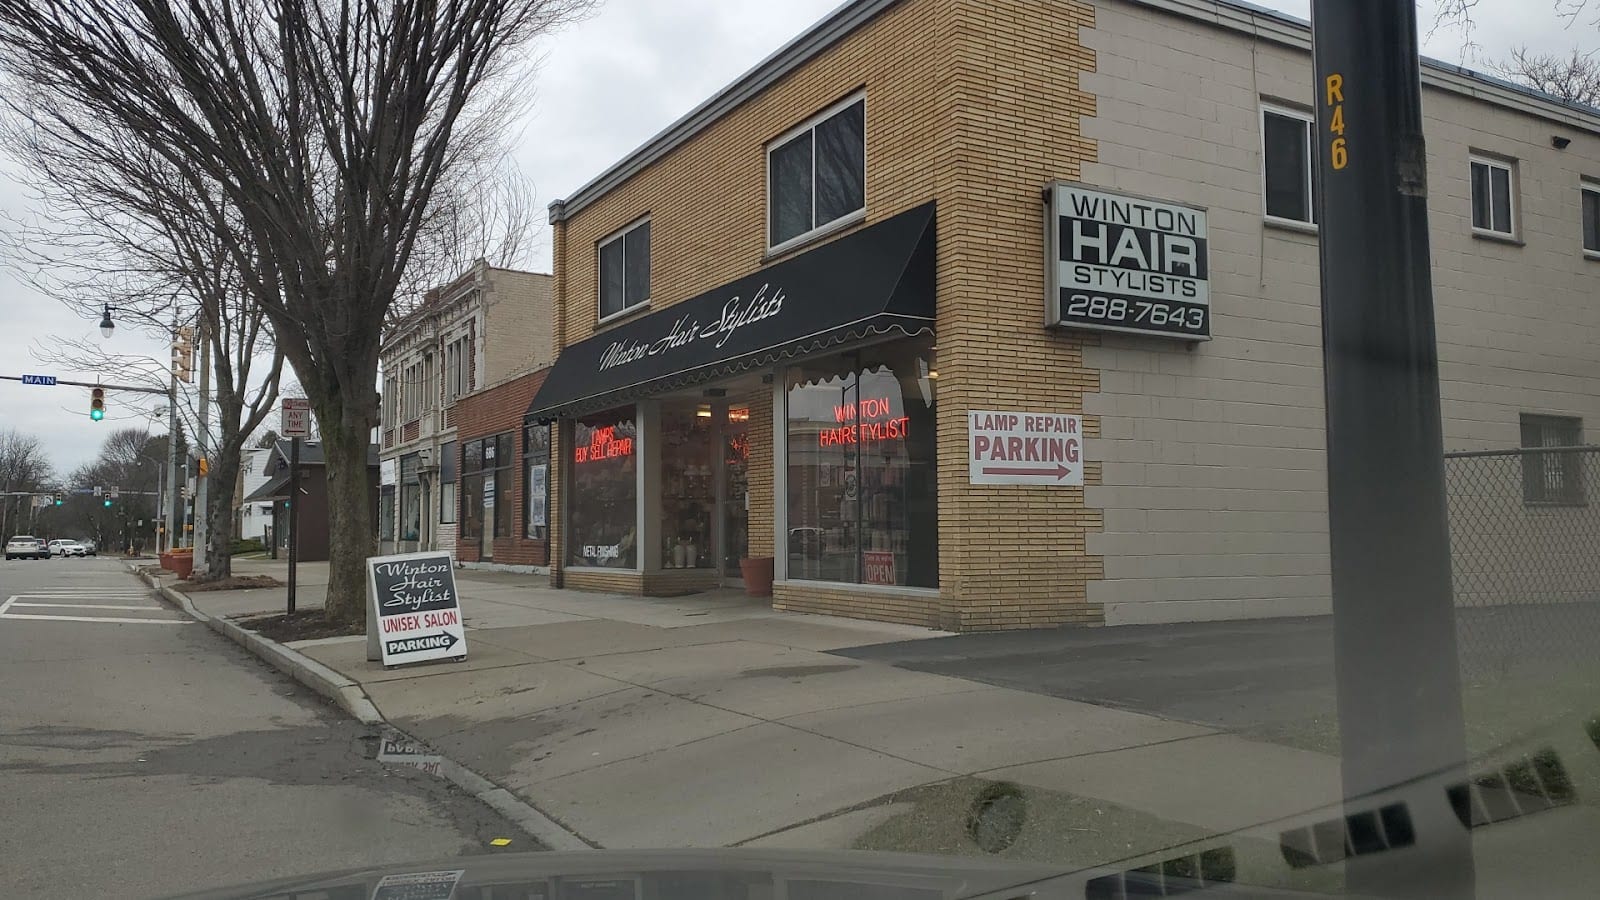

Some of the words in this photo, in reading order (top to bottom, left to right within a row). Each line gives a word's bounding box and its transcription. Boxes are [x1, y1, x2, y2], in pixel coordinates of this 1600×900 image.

[1326, 73, 1348, 170] R46
[1070, 193, 1196, 235] WINTON
[1072, 219, 1198, 277] HAIR
[1074, 265, 1196, 297] STYLISTS
[1067, 294, 1204, 329] 288-7643
[598, 337, 649, 373] Winton
[648, 313, 700, 355] Hair
[699, 283, 786, 348] Stylists
[24, 376, 55, 385] MAIN
[288, 411, 304, 420] ANY
[834, 398, 888, 422] WINTON
[288, 420, 304, 428] TIME
[820, 417, 909, 447] HAIRSTYLIST
[974, 413, 1019, 432] LAMP
[1024, 415, 1077, 434] REPAIR
[974, 435, 1079, 463] PARKING
[376, 562, 448, 577] Winton
[867, 564, 894, 583] OPEN
[389, 574, 442, 592] Hair
[383, 588, 451, 610] Stylist
[383, 616, 420, 633] UNISEX
[424, 611, 457, 628] SALON
[388, 636, 450, 653] PARKING
